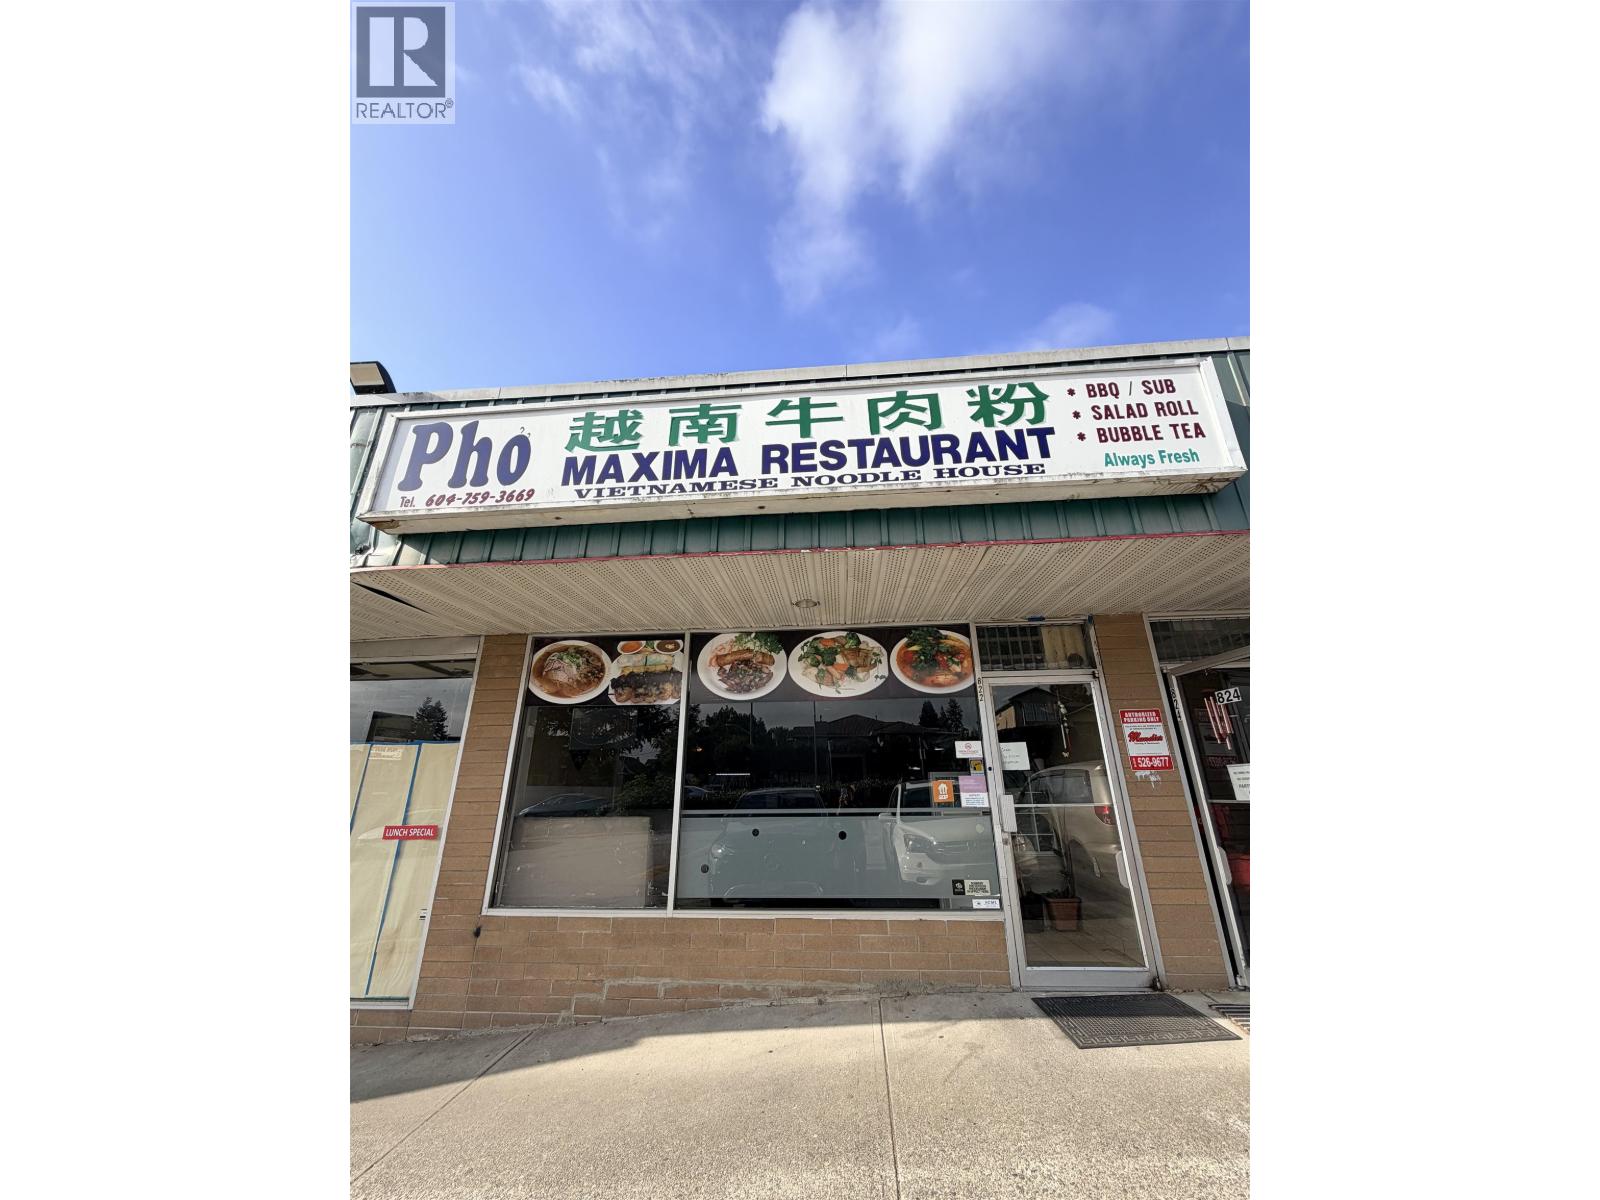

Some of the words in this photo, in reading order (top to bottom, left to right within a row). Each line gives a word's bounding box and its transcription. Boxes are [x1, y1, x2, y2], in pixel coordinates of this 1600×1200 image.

[1085, 381, 1120, 399] BBQ
[1141, 378, 1176, 395] SUB
[565, 381, 1050, 452] 越南牛肉粉
[1091, 402, 1148, 420] SALAD
[1154, 399, 1199, 417] ROLL
[1096, 424, 1164, 443] BUBBLE
[1169, 422, 1206, 439] TEA
[561, 446, 739, 487] MAXIMA
[761, 426, 1055, 475] RESTAURANT
[1104, 452, 1155, 469] Always
[1158, 448, 1200, 464] Fresh
[575, 477, 778, 499] VIETNAMESE
[791, 469, 922, 487] NOODLE
[933, 463, 1046, 479] HOUSE
[400, 496, 416, 508] Tel.
[425, 488, 535, 507] 604-759-3669
[1216, 688, 1240, 704] 824
[1137, 756, 1169, 768] 526-9677
[385, 828, 408, 837] LUNCH
[408, 827, 434, 836] SPECIAL
